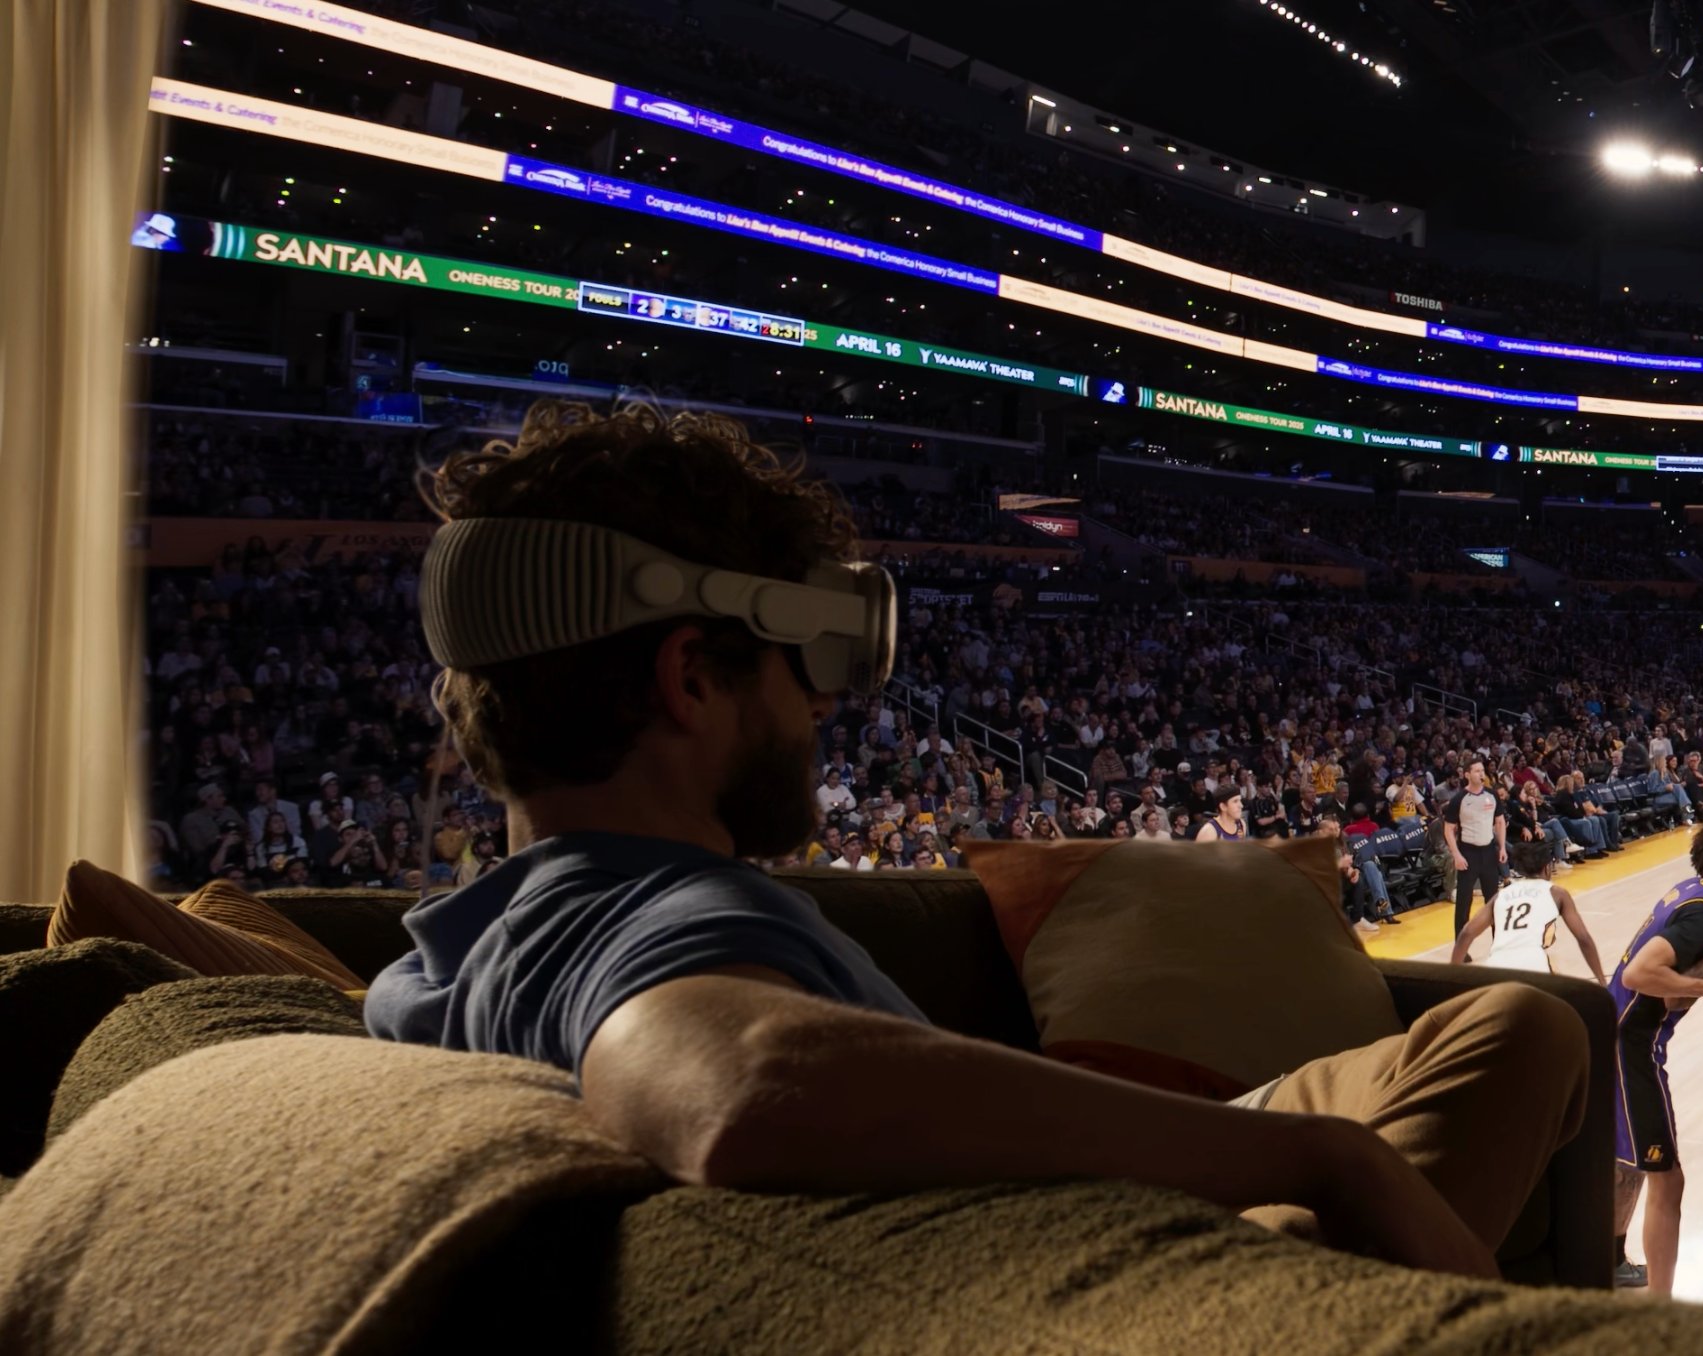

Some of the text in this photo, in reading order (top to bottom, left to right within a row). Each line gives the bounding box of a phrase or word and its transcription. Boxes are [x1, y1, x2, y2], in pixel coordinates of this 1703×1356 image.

[227, 104, 278, 125] Catering
[762, 137, 826, 161] Congratulations
[828, 155, 836, 165] to
[934, 186, 963, 203] Catering
[965, 196, 976, 207] the
[976, 200, 1008, 216] Comerica
[1008, 210, 1038, 226] Honorary
[1038, 218, 1056, 231] Small
[1056, 225, 1084, 239] Business
[645, 196, 715, 219] Congratulations
[716, 211, 726, 223] to
[825, 236, 832, 247] &
[833, 239, 865, 256] Catering
[867, 247, 878, 258] the
[879, 252, 914, 266] Comerica
[915, 261, 945, 276] Honorary
[946, 268, 966, 280] Small
[967, 273, 996, 288] Business
[255, 233, 428, 283] SANTANA
[448, 270, 520, 292] ONENESS
[523, 280, 562, 298] TOUR
[588, 291, 682, 319] FOULS 2 3
[1394, 292, 1443, 311] TOSHIBA
[710, 312, 801, 340] 37 42 2 8:31
[836, 333, 882, 355] APRIL
[885, 341, 901, 357] 16
[989, 362, 1035, 382] THEATER
[1155, 393, 1227, 421] SANTANA
[1235, 411, 1268, 426] ONENESS
[1269, 416, 1288, 428] TOUR
[1314, 423, 1341, 438] APRIL
[1342, 428, 1353, 440] 16
[1409, 438, 1443, 450] THEATER
[1534, 449, 1598, 465] SANTANA
[1382, 833, 1399, 843] DELTA
[1503, 902, 1531, 931] 12
